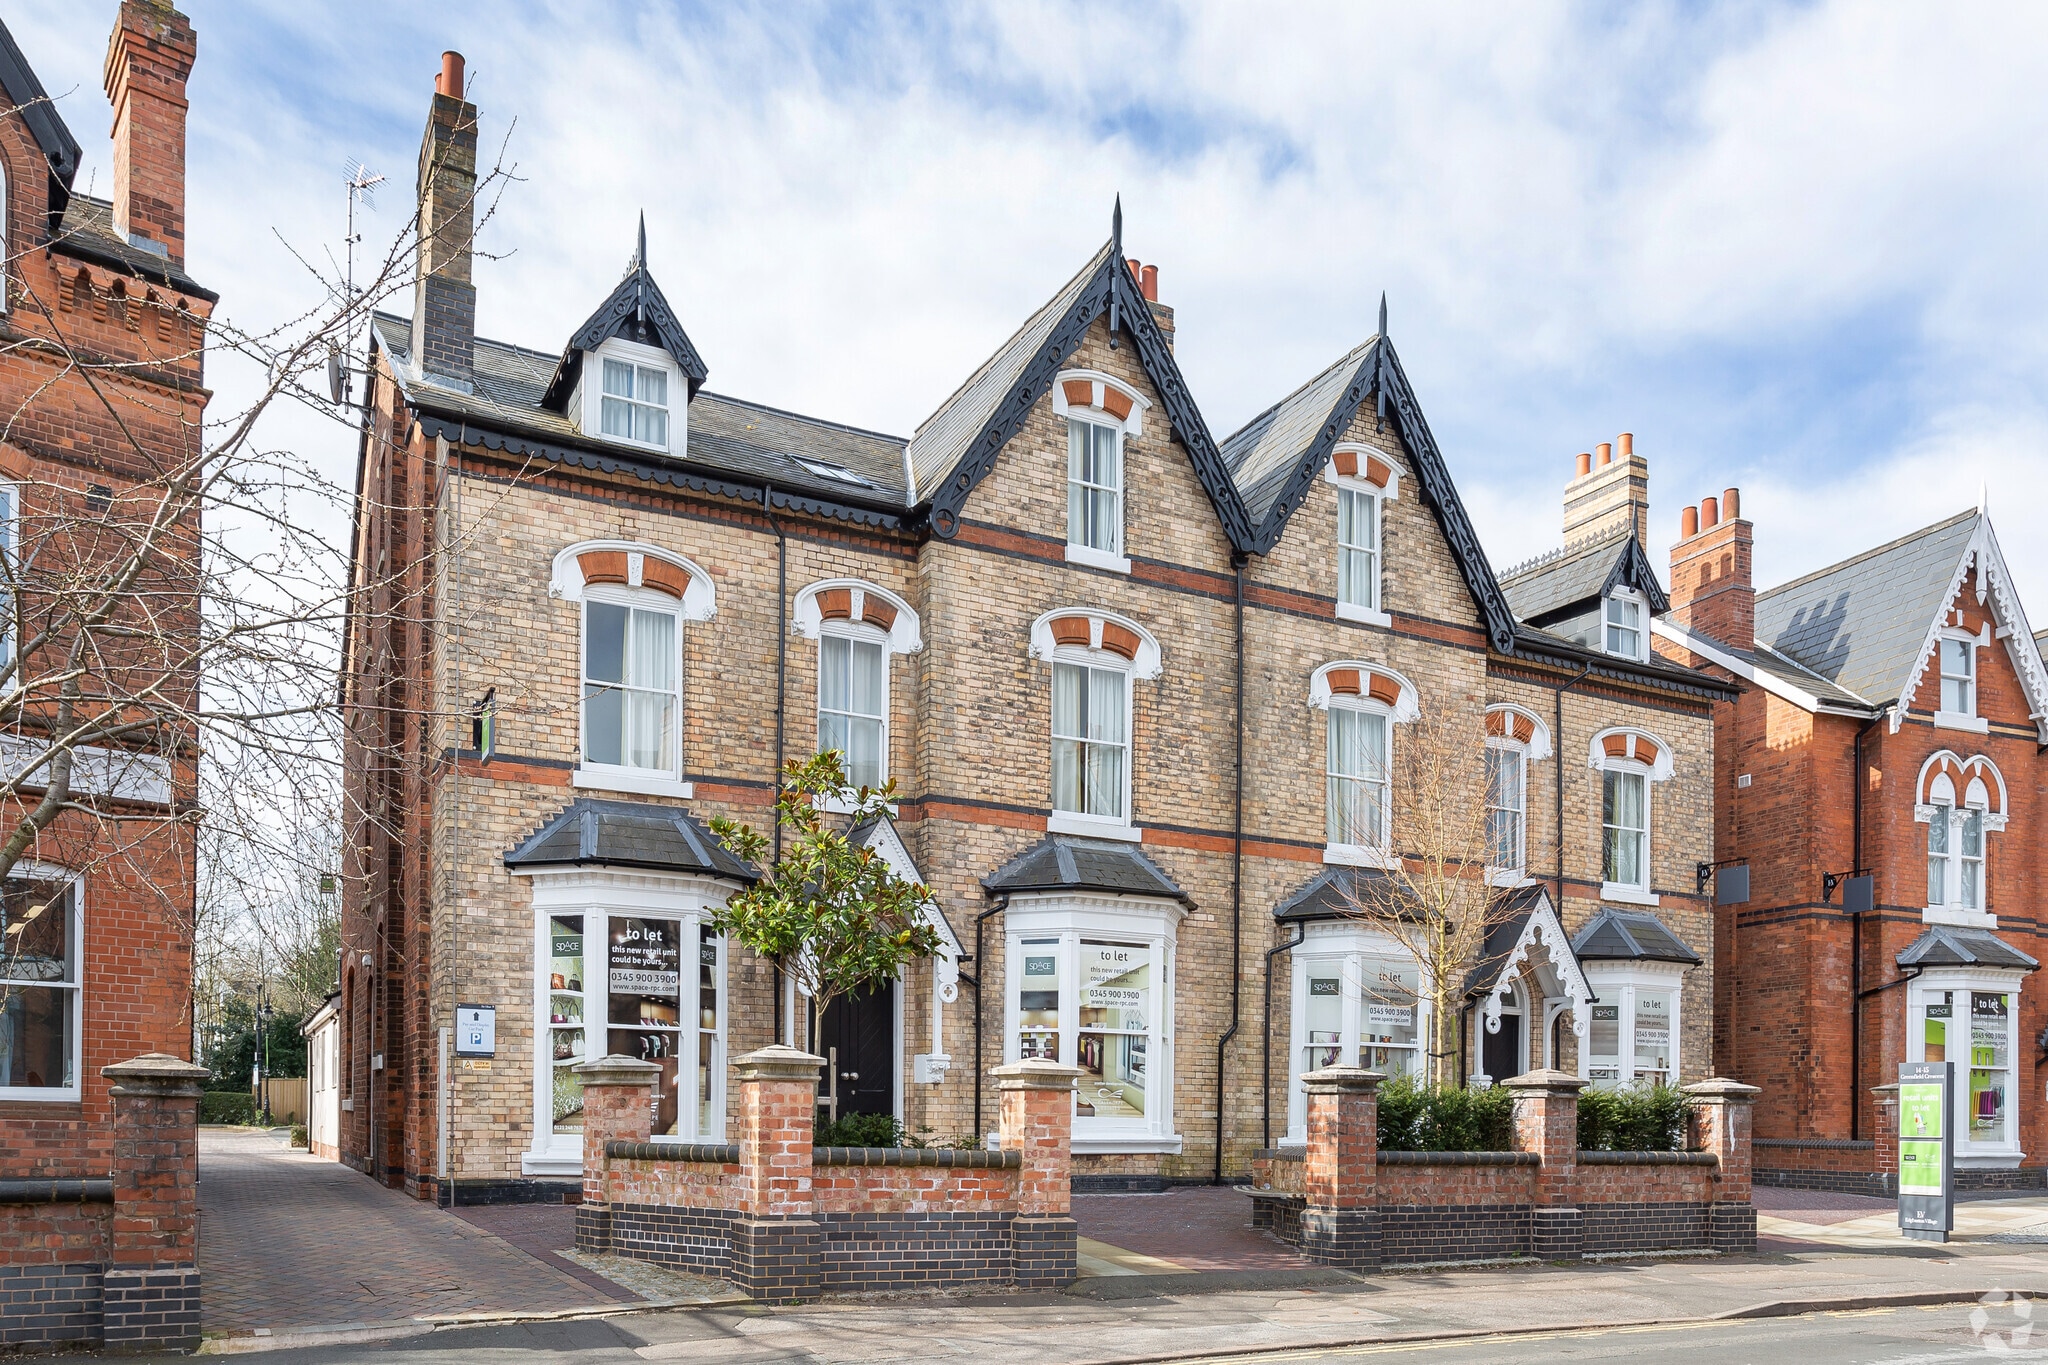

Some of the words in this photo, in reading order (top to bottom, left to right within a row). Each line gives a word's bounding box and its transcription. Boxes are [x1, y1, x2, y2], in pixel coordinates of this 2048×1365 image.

[626, 929, 640, 940] to
[644, 928, 662, 941] let
[1101, 951, 1110, 960] to
[1115, 950, 1128, 961] let
[612, 973, 634, 981] 0345
[636, 974, 652, 982] 900
[655, 975, 676, 983] 3900
[1390, 972, 1401, 982] let
[613, 984, 674, 992] www.space-rpc.com
[1652, 1000, 1661, 1008] let
[1979, 1000, 1987, 1008] to
[1988, 999, 1998, 1009] let
[472, 1034, 480, 1044] P
